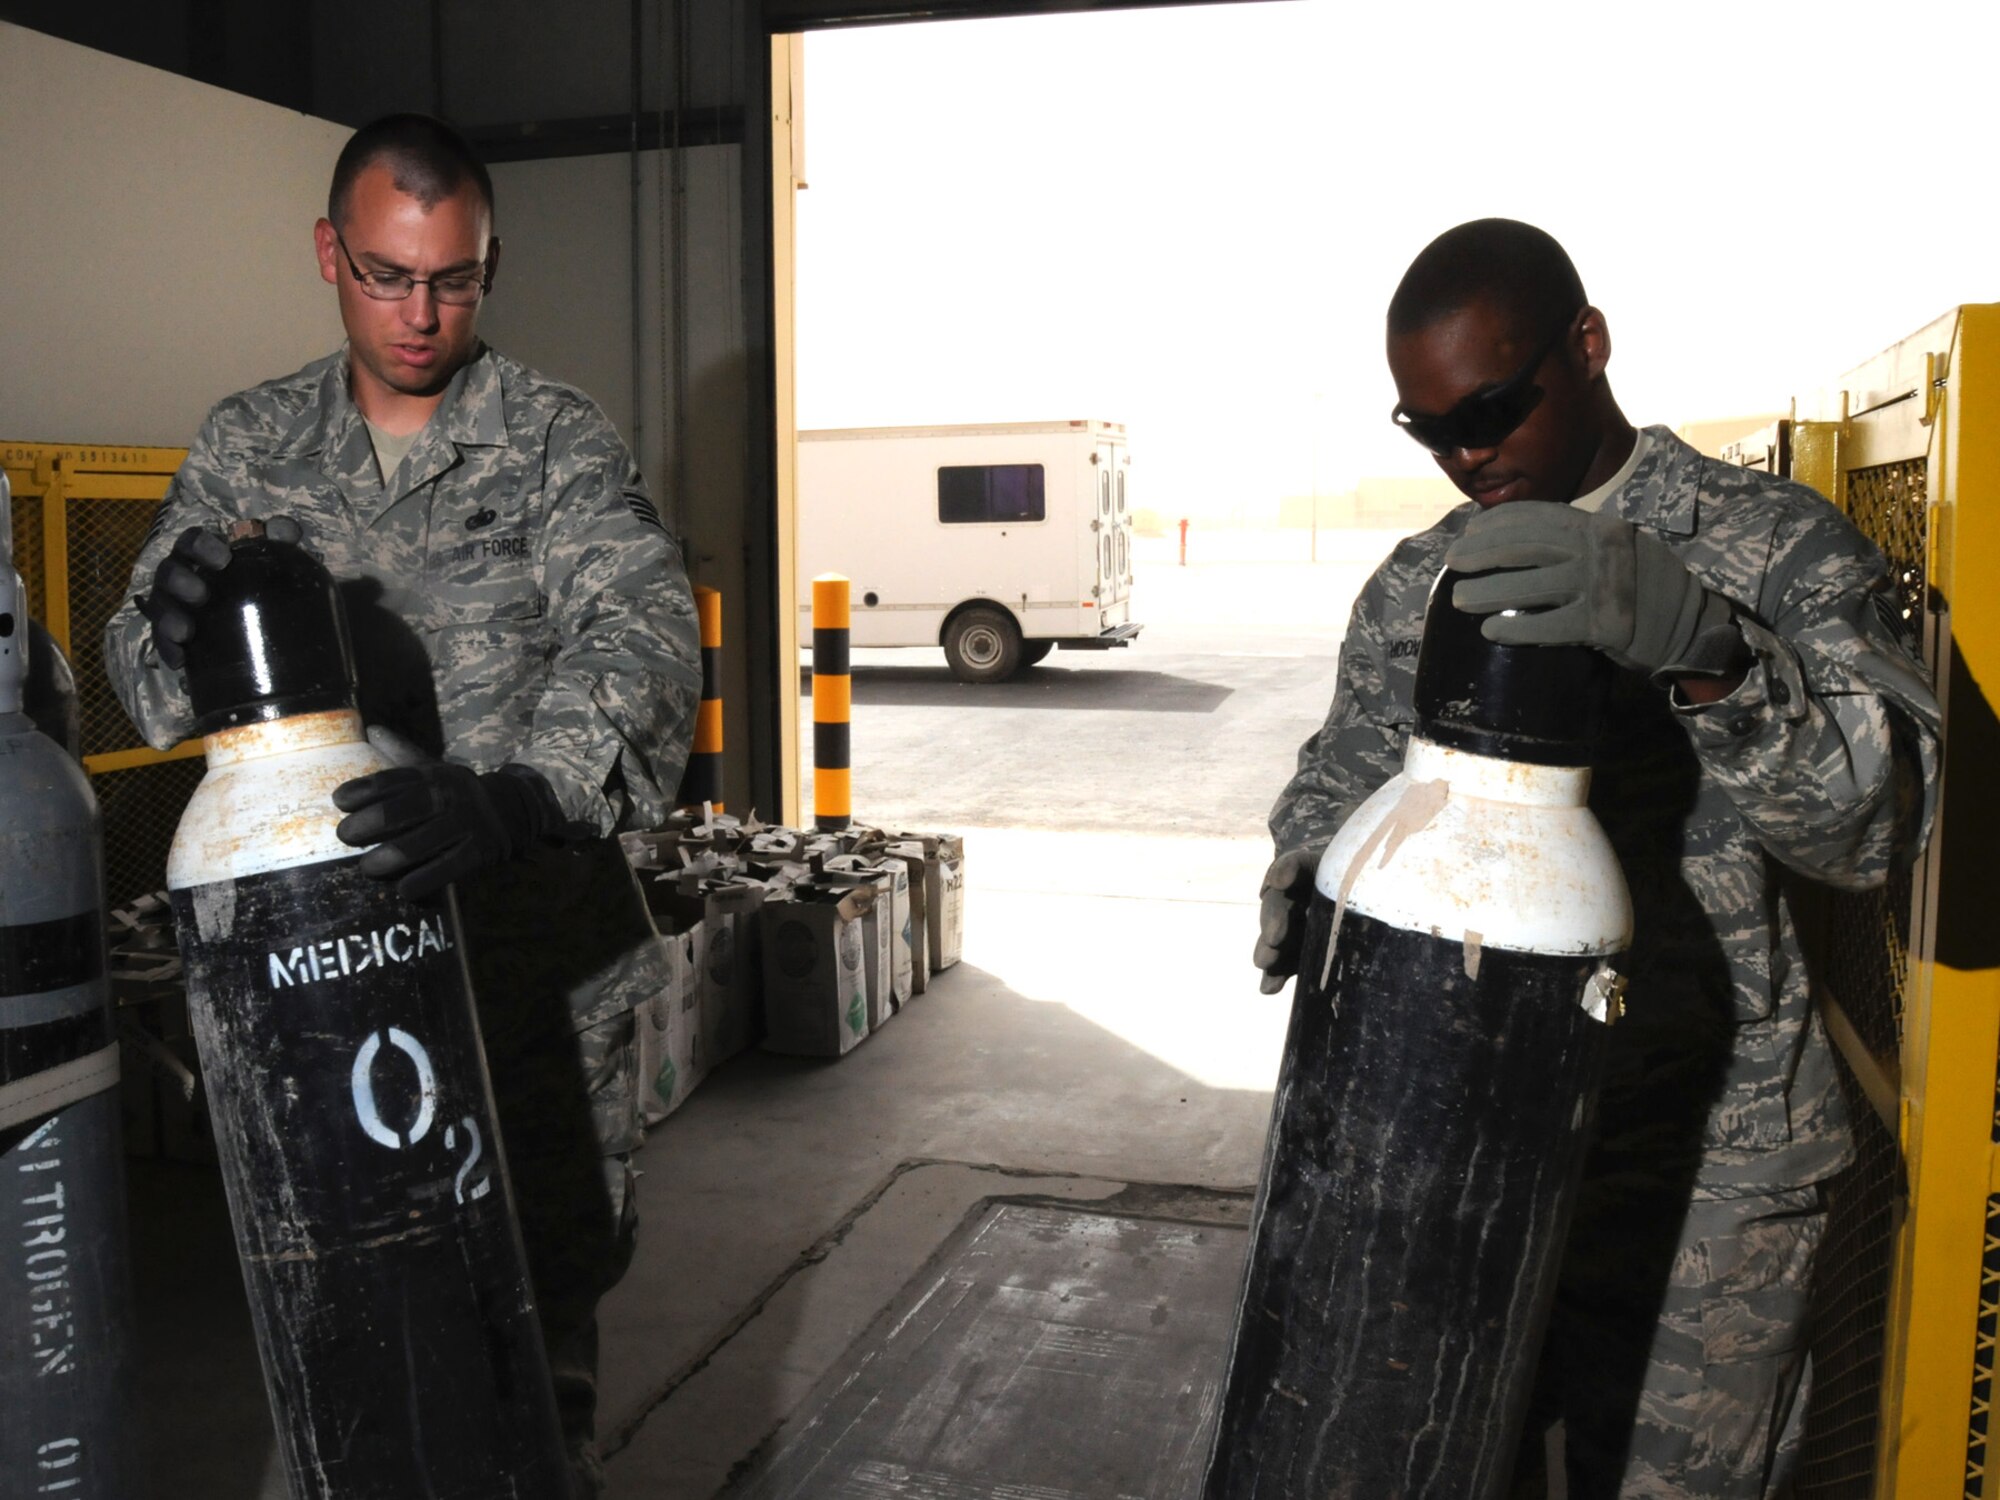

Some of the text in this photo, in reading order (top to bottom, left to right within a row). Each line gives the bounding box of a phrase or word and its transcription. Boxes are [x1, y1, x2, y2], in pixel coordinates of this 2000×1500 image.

[452, 543, 475, 561] AIR
[482, 537, 529, 558] FORCE
[268, 914, 454, 989] MEDICAL
[18, 1115, 75, 1377] NITROGEN
